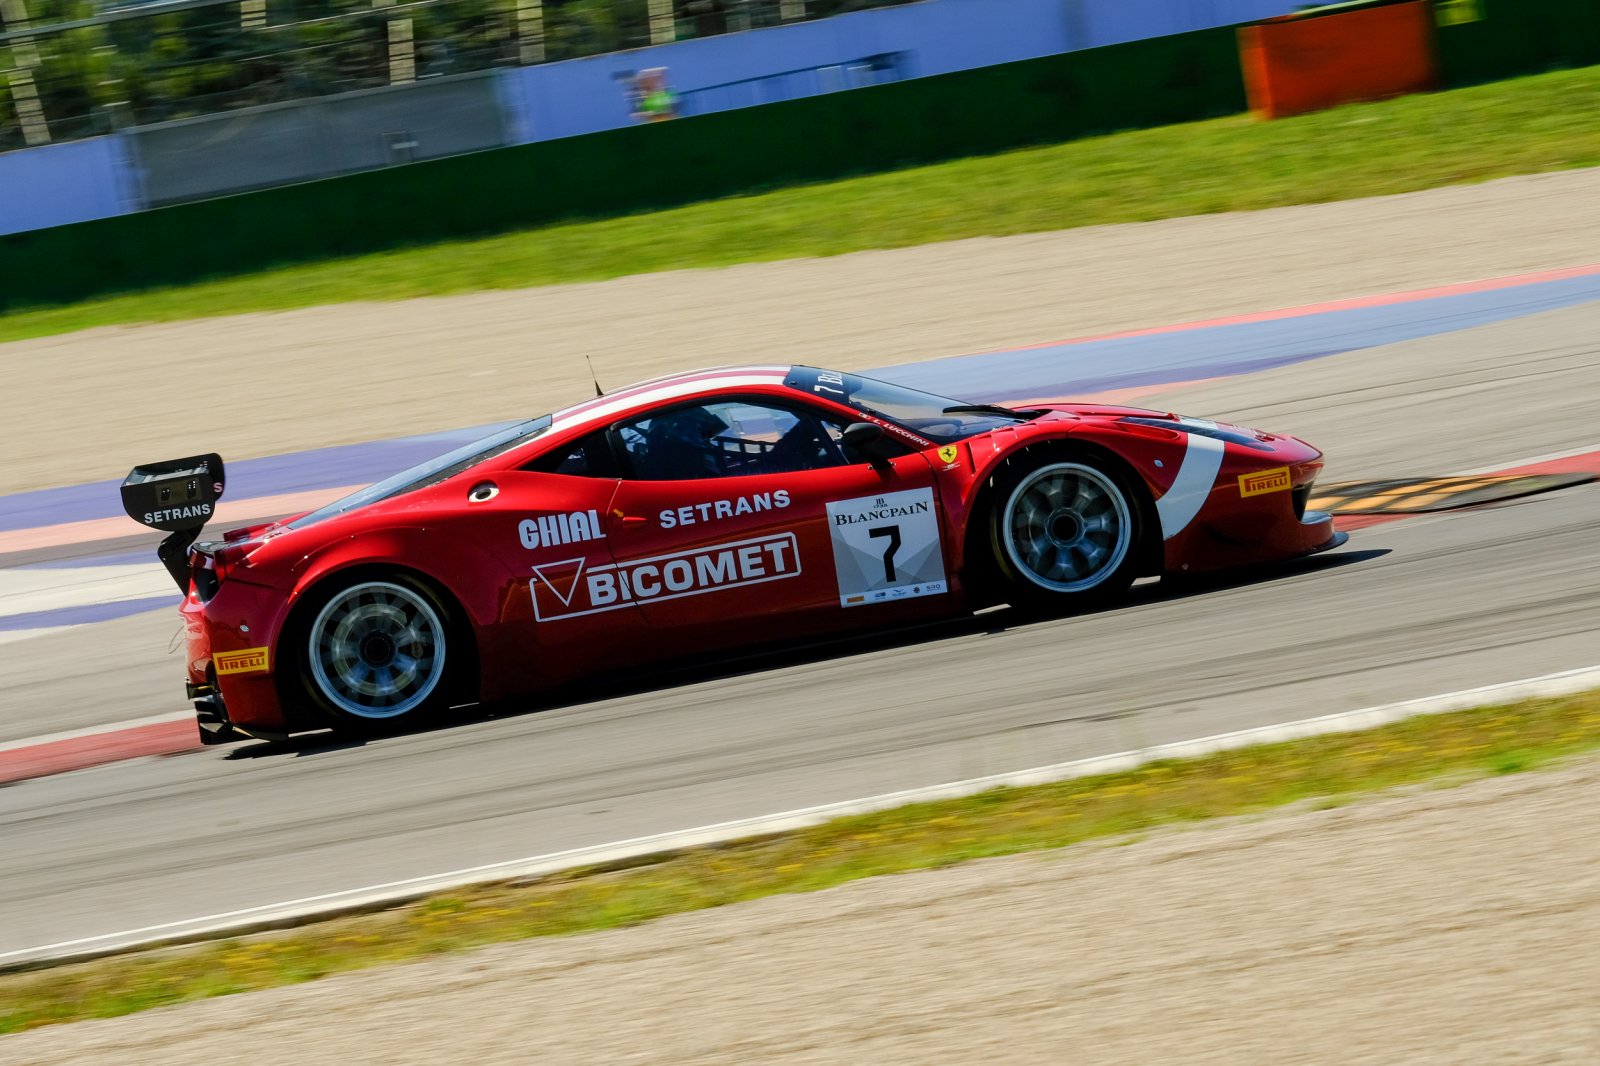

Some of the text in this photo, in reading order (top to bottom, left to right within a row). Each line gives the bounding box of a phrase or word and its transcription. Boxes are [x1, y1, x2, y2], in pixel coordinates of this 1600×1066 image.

[814, 385, 844, 394] 7
[883, 423, 929, 445] LUCCHINI
[1244, 471, 1288, 492] PIRELLI
[144, 503, 211, 524] SETRANS
[660, 489, 791, 529] SETRANS
[835, 501, 928, 525] BLANCPAIN
[518, 509, 607, 550] GHIAL
[868, 524, 901, 582] 7
[586, 540, 790, 607] BICOMET
[217, 651, 265, 671] PIRELLI
